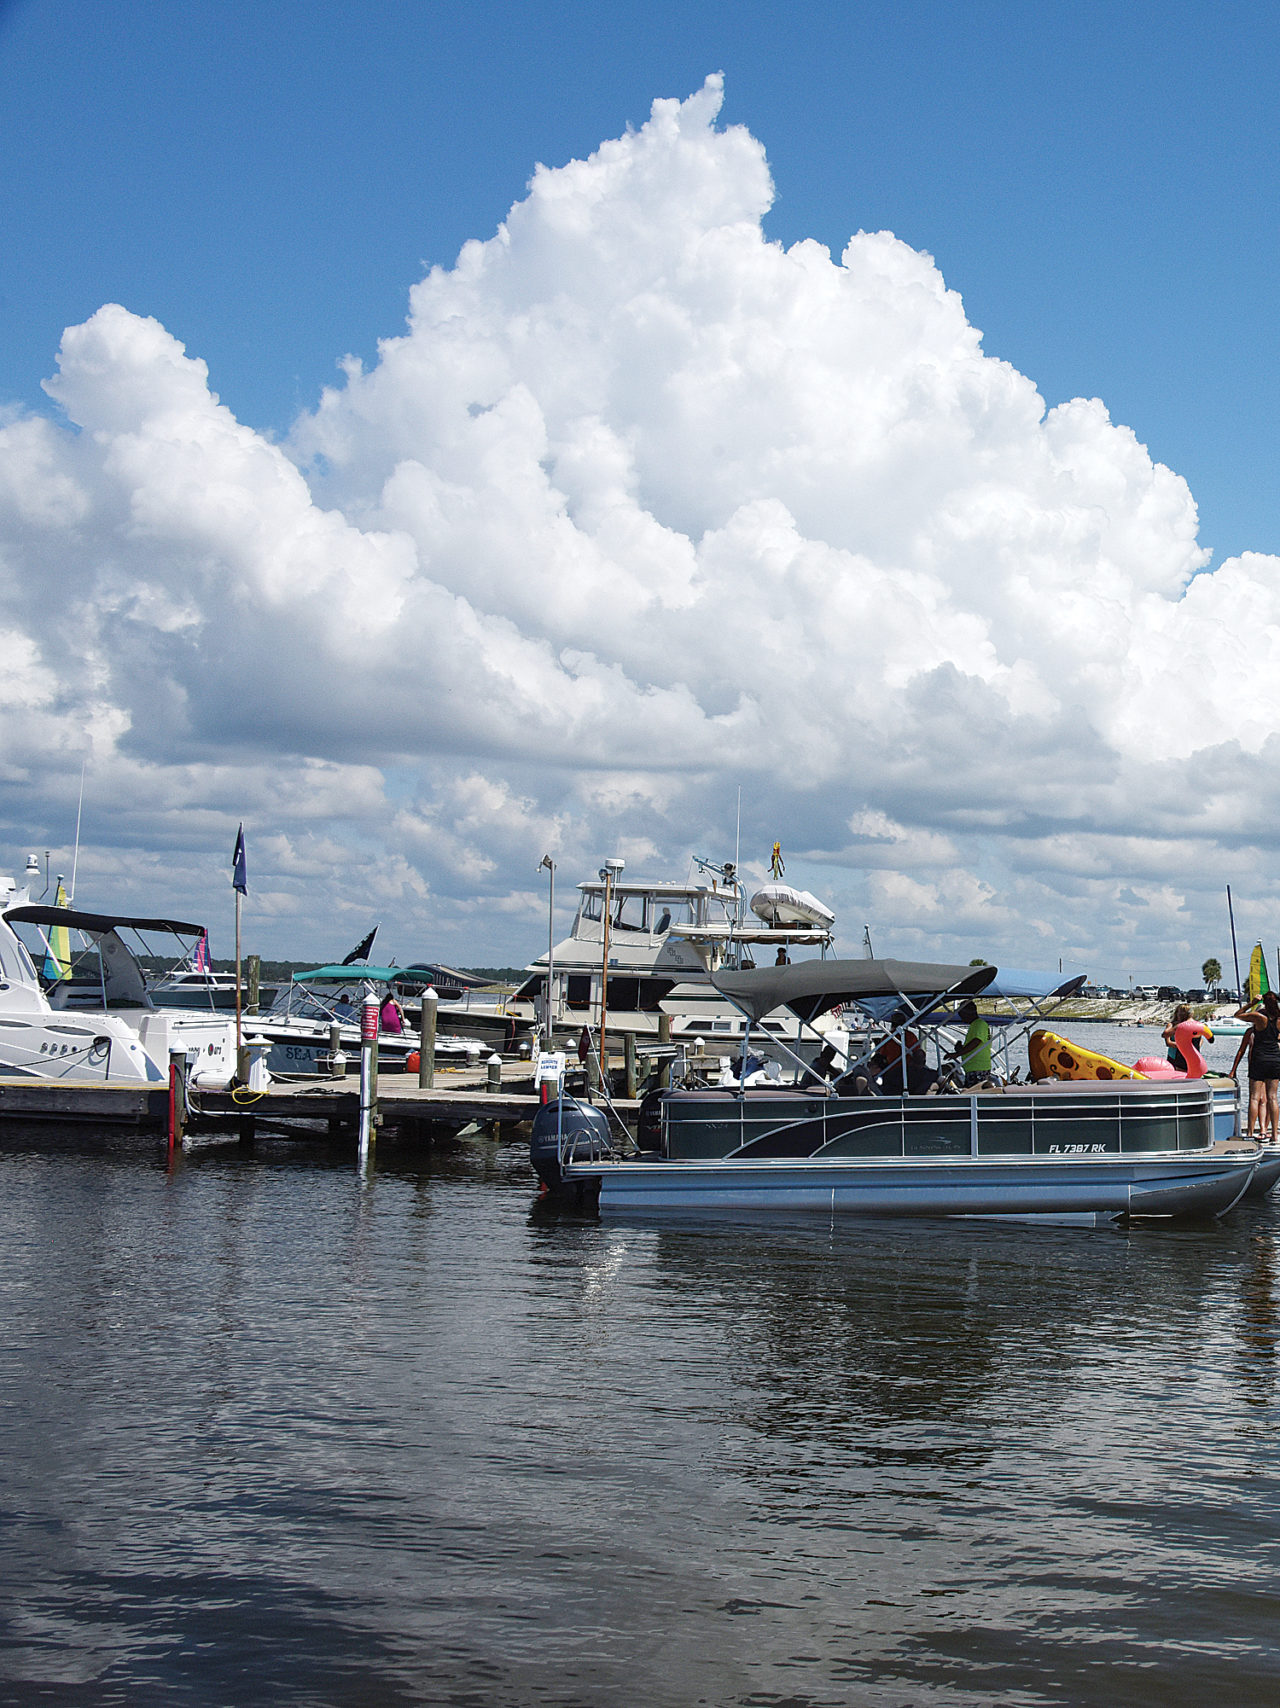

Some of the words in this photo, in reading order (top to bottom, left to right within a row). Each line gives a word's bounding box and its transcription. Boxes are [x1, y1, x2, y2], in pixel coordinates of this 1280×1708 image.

[286, 1047, 312, 1060] SEA
[1049, 1145, 1061, 1153] FL
[1091, 1144, 1106, 1152] RK
